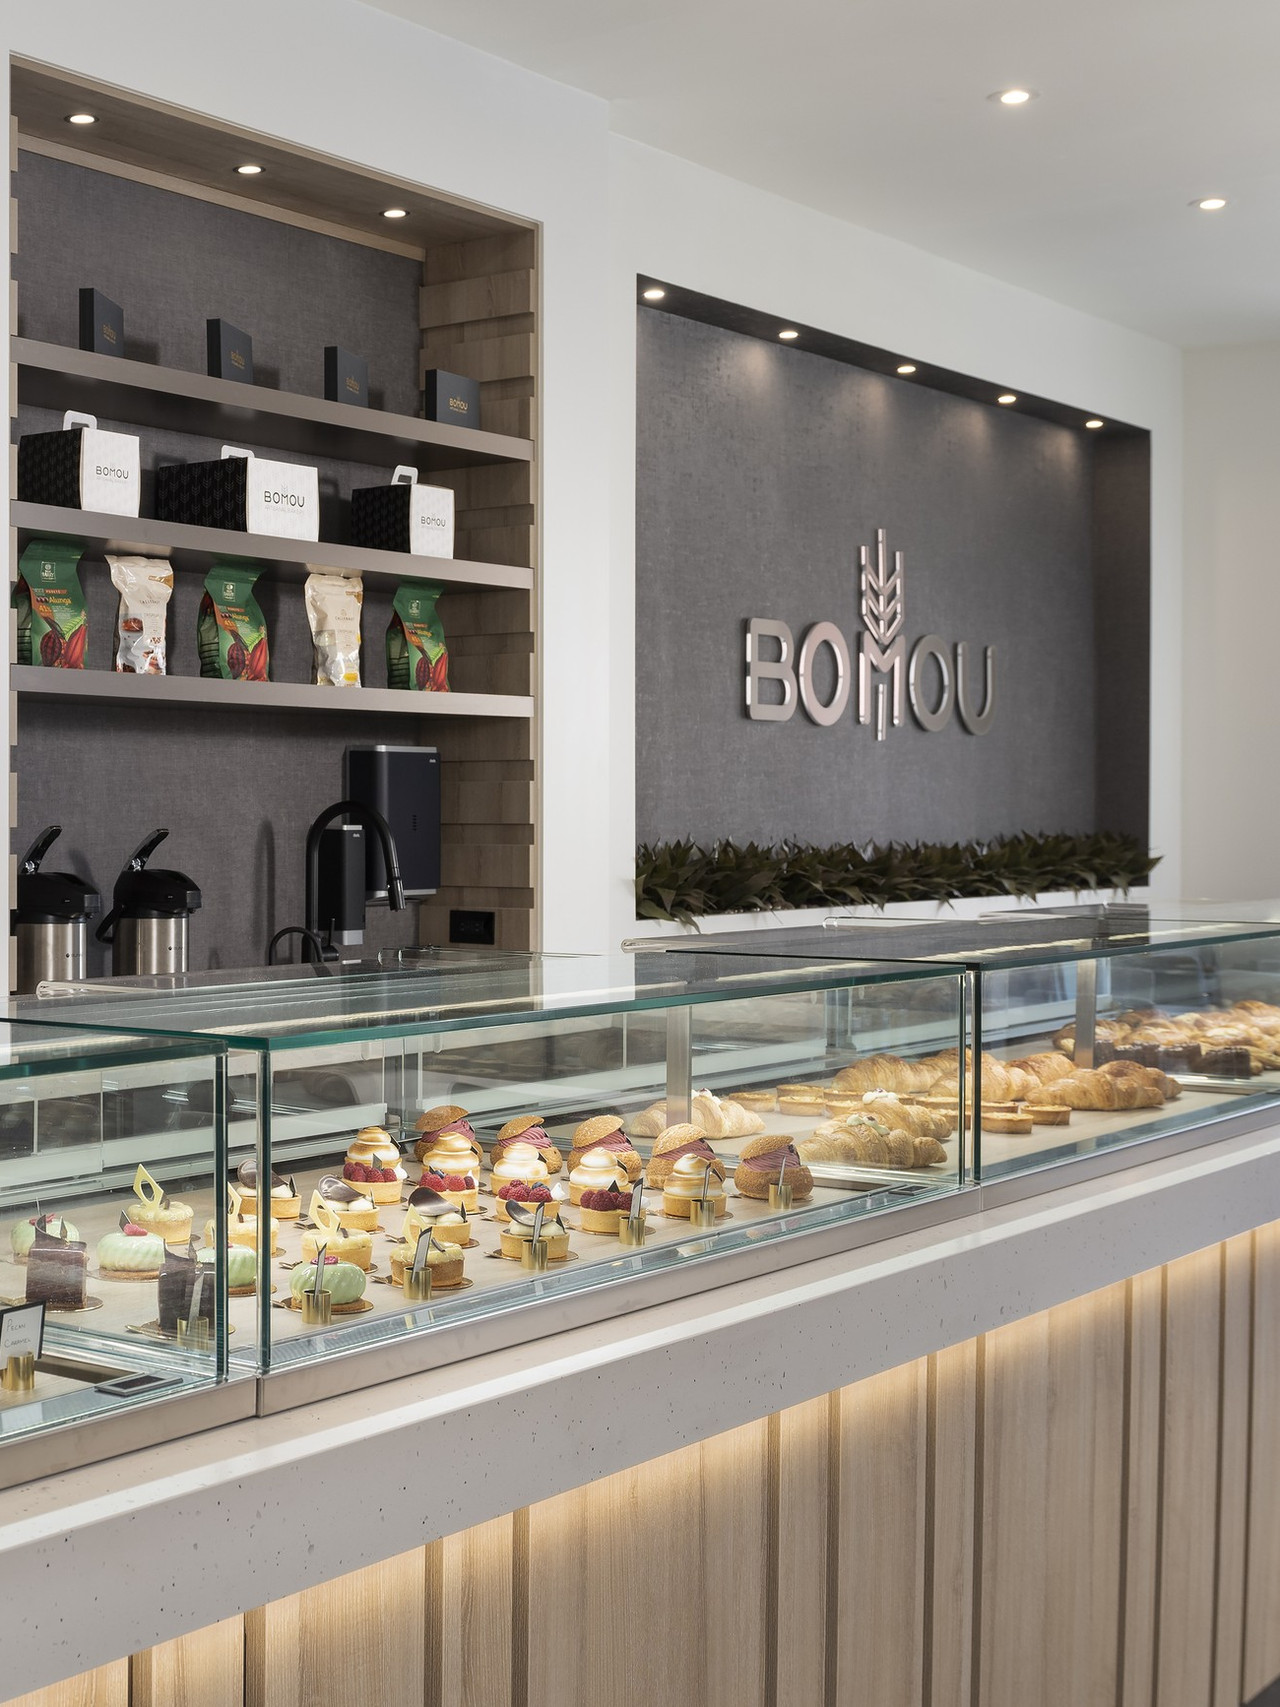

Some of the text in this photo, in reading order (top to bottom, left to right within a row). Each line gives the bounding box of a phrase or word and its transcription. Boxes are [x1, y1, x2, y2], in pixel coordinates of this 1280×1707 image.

[449, 396, 468, 410] BOMOU
[95, 465, 129, 479] BOMOU
[264, 490, 305, 507] BOMOU
[420, 516, 446, 527] BOMOU
[745, 616, 996, 737] BOMOU
